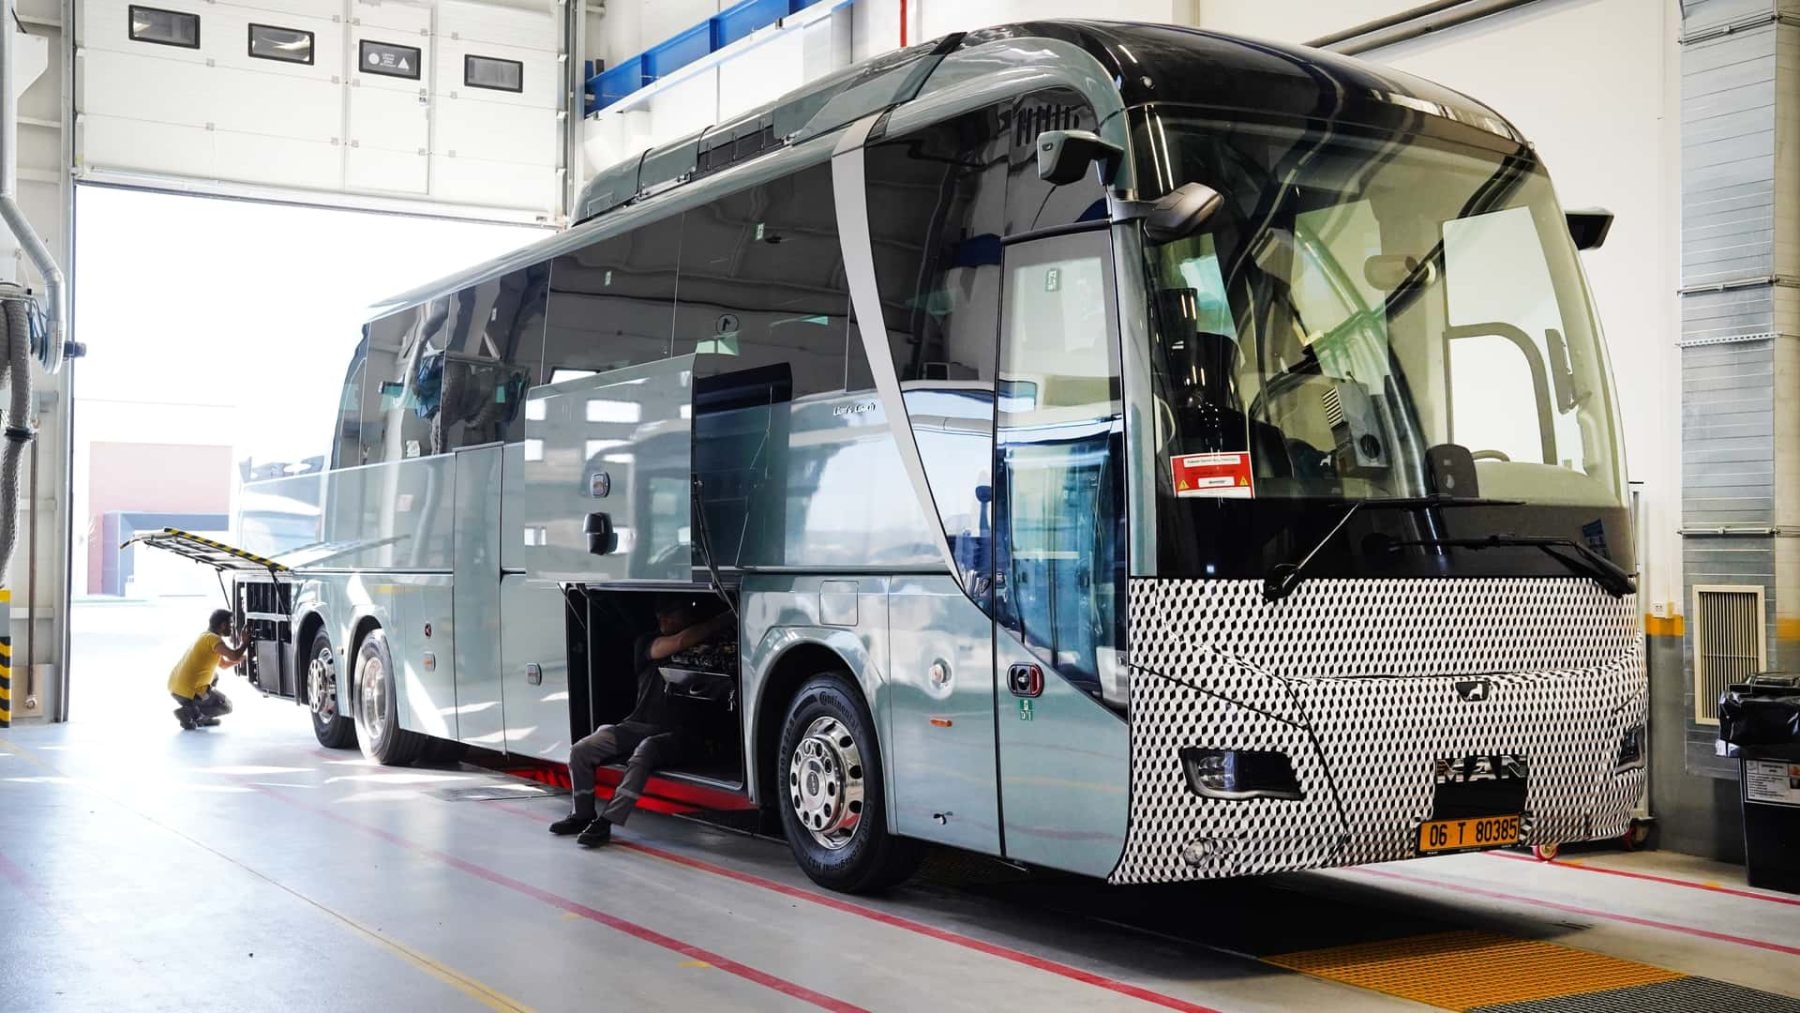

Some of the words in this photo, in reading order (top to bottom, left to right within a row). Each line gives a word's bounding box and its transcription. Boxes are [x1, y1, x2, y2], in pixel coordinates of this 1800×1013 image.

[819, 691, 858, 732] Continental
[1436, 755, 1527, 784] MAN
[1429, 824, 1448, 847] 06
[1457, 822, 1467, 845] T
[1475, 818, 1518, 843] 80385
